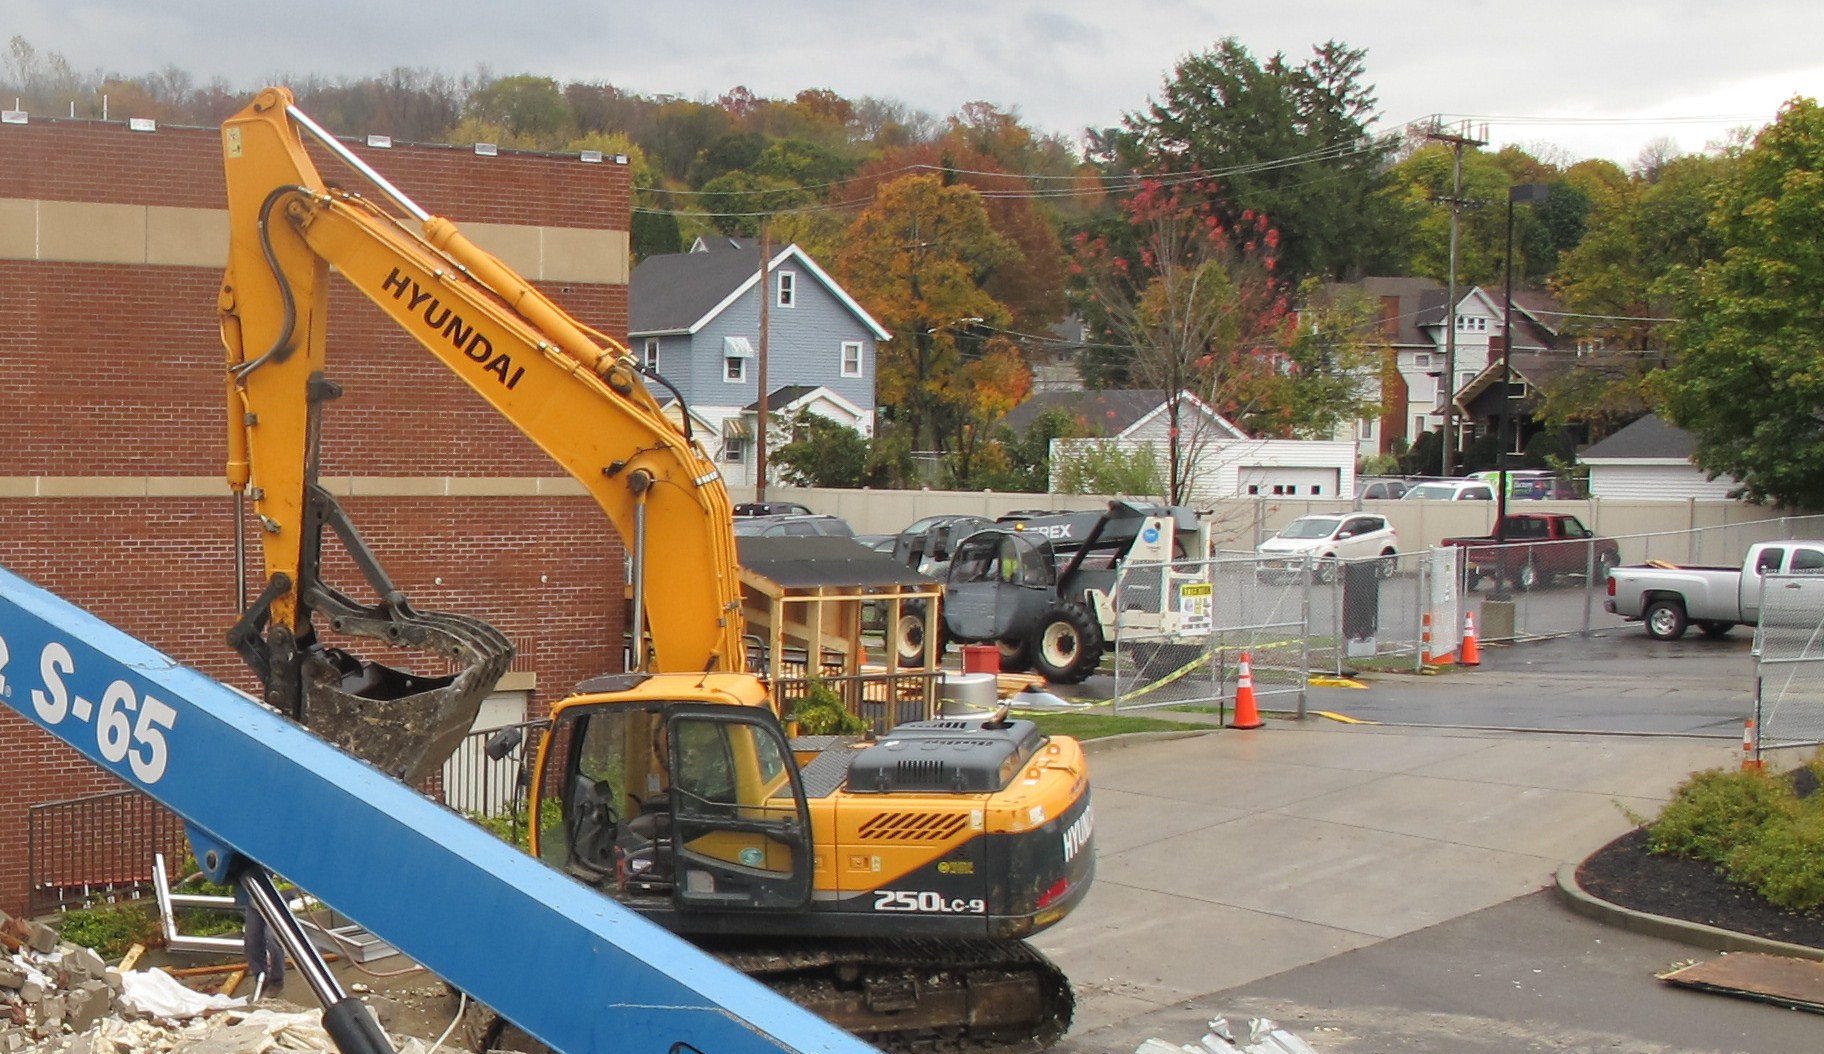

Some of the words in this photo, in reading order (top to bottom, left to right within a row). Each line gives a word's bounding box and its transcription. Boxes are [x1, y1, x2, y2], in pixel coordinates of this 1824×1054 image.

[381, 266, 526, 391] HYUNDAI
[1027, 524, 1072, 539] REX
[30, 641, 178, 784] S-65
